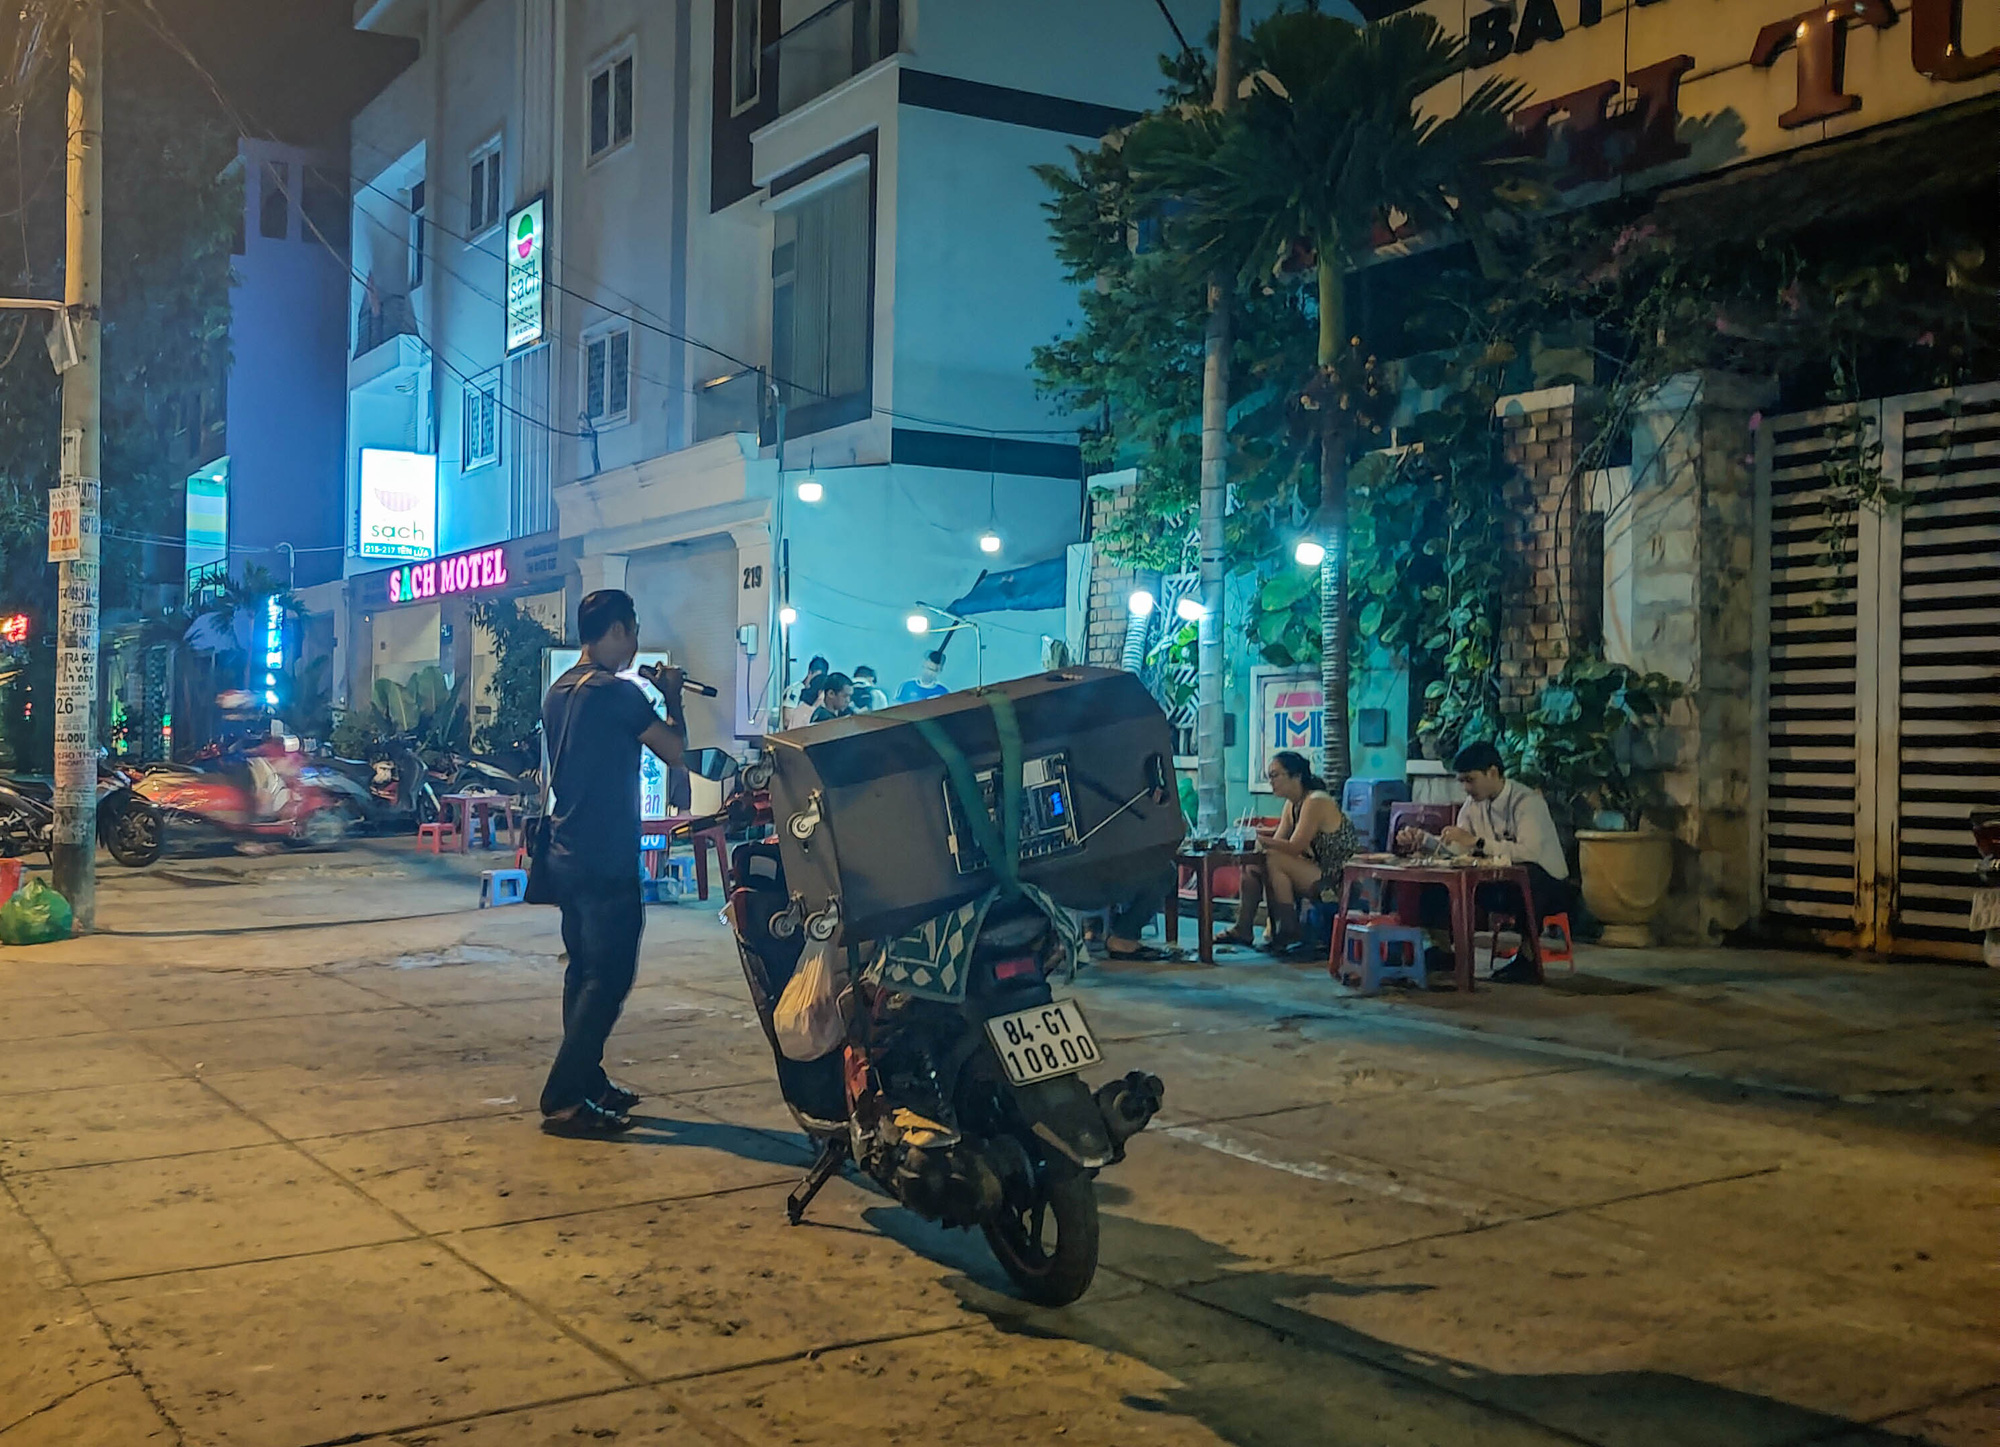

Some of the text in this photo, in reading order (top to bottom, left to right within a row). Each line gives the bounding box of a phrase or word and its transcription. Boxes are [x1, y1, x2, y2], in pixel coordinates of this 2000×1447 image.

[52, 509, 71, 537] 379
[371, 520, 424, 541] sạch
[440, 548, 507, 594] MOTEL
[743, 565, 762, 590] 219
[57, 696, 74, 715] 26
[1003, 1007, 1071, 1046] 84-G1
[1007, 1035, 1095, 1078] 108.00
